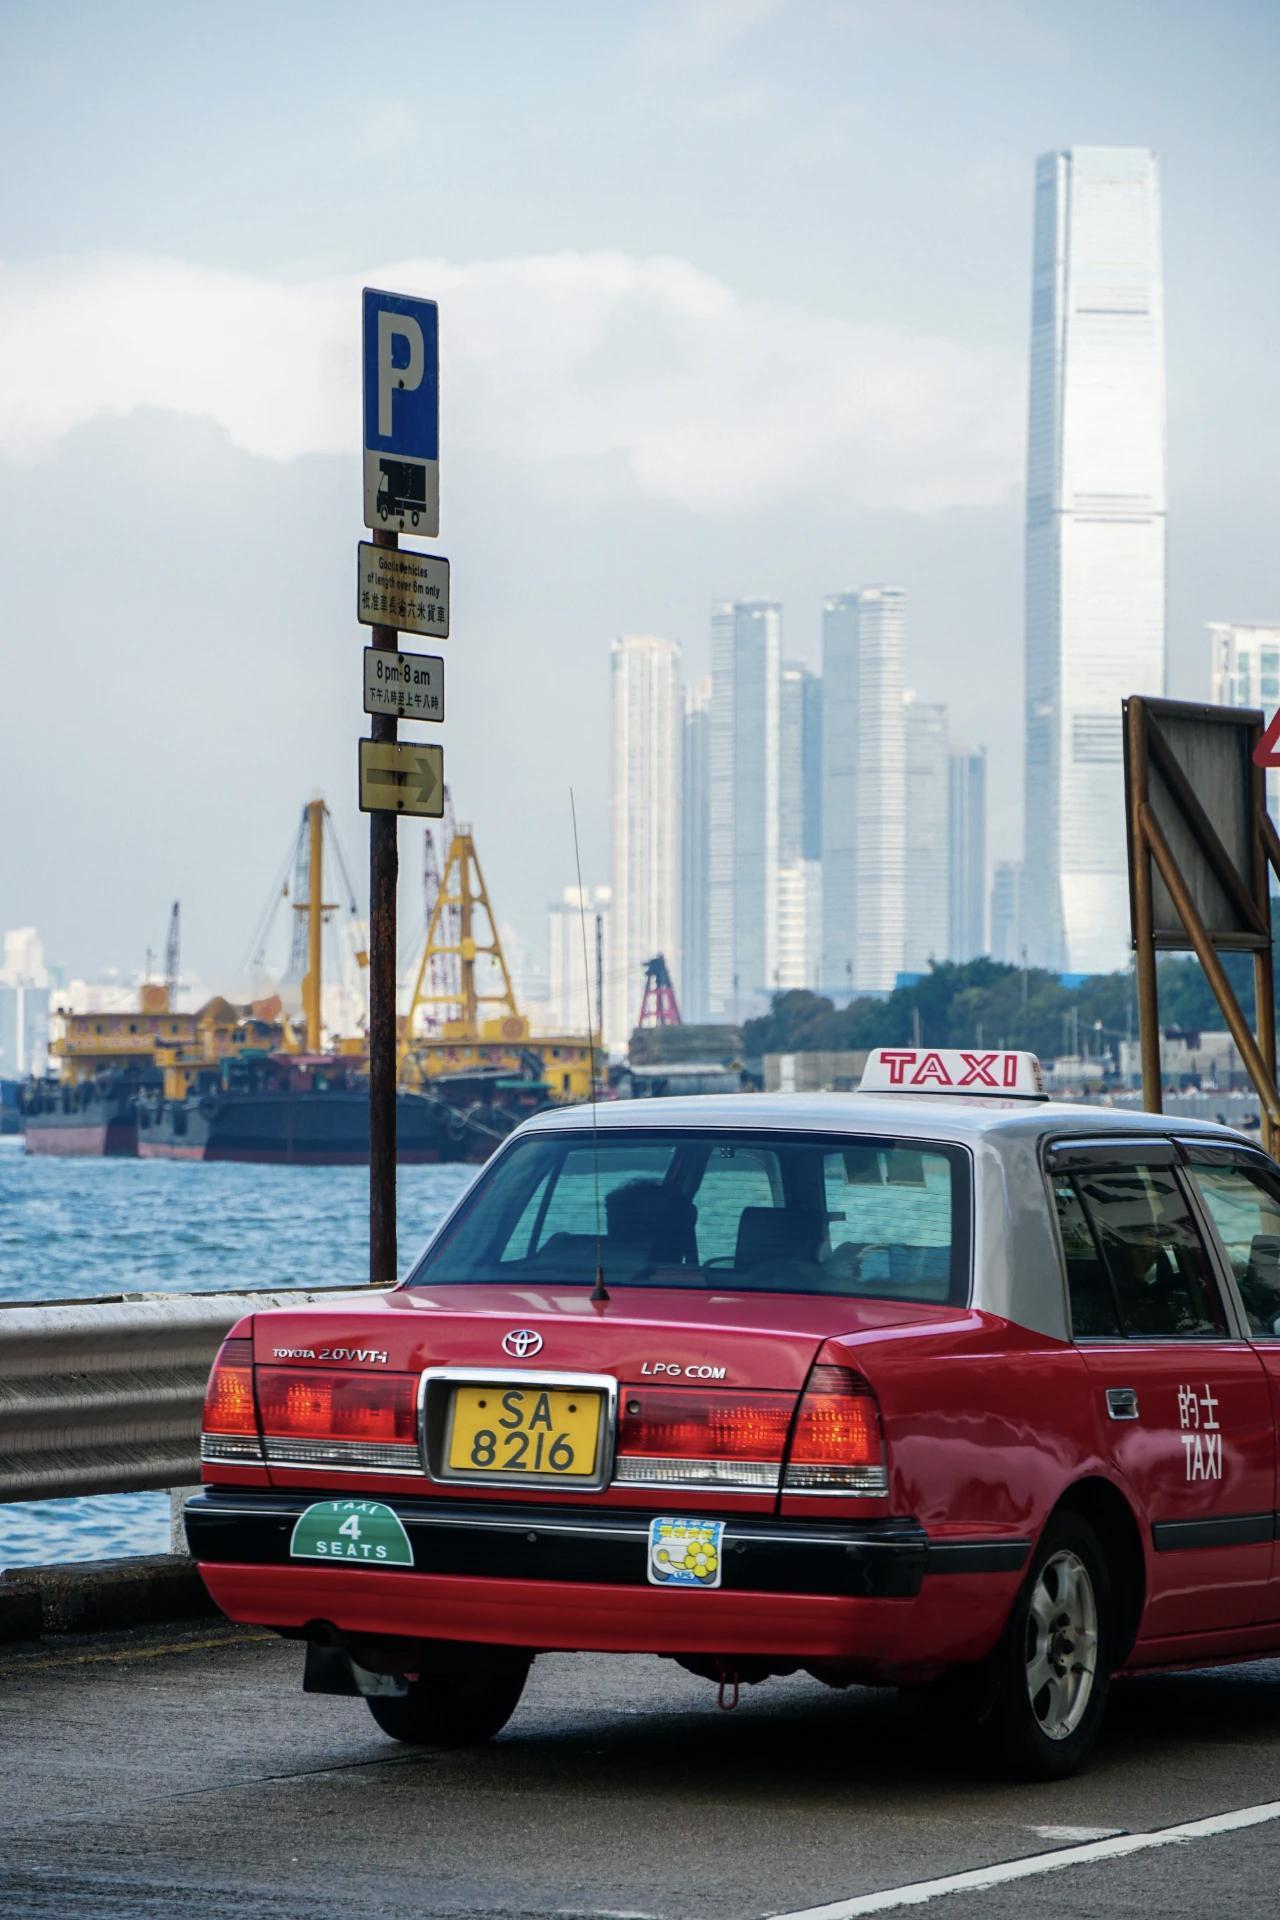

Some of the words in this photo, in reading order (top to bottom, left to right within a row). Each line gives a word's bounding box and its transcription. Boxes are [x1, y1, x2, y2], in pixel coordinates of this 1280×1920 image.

[378, 310, 424, 437] P
[367, 572, 374, 584] of
[397, 579, 411, 592] over
[413, 580, 424, 594] 6m
[425, 584, 440, 600] only
[369, 687, 439, 711] 下午八時至上午八時
[880, 1052, 1018, 1087] TAXI
[272, 1348, 315, 1359] TOYOTA
[641, 1362, 681, 1376] LPG
[685, 1365, 726, 1379] COM
[498, 1391, 553, 1431] SA
[1178, 1384, 1220, 1429] 的士
[470, 1429, 575, 1471] 8216
[1181, 1434, 1222, 1481] TAXI
[330, 1502, 379, 1515] TAXI
[338, 1514, 362, 1540] 4
[316, 1541, 387, 1558] SEATS
